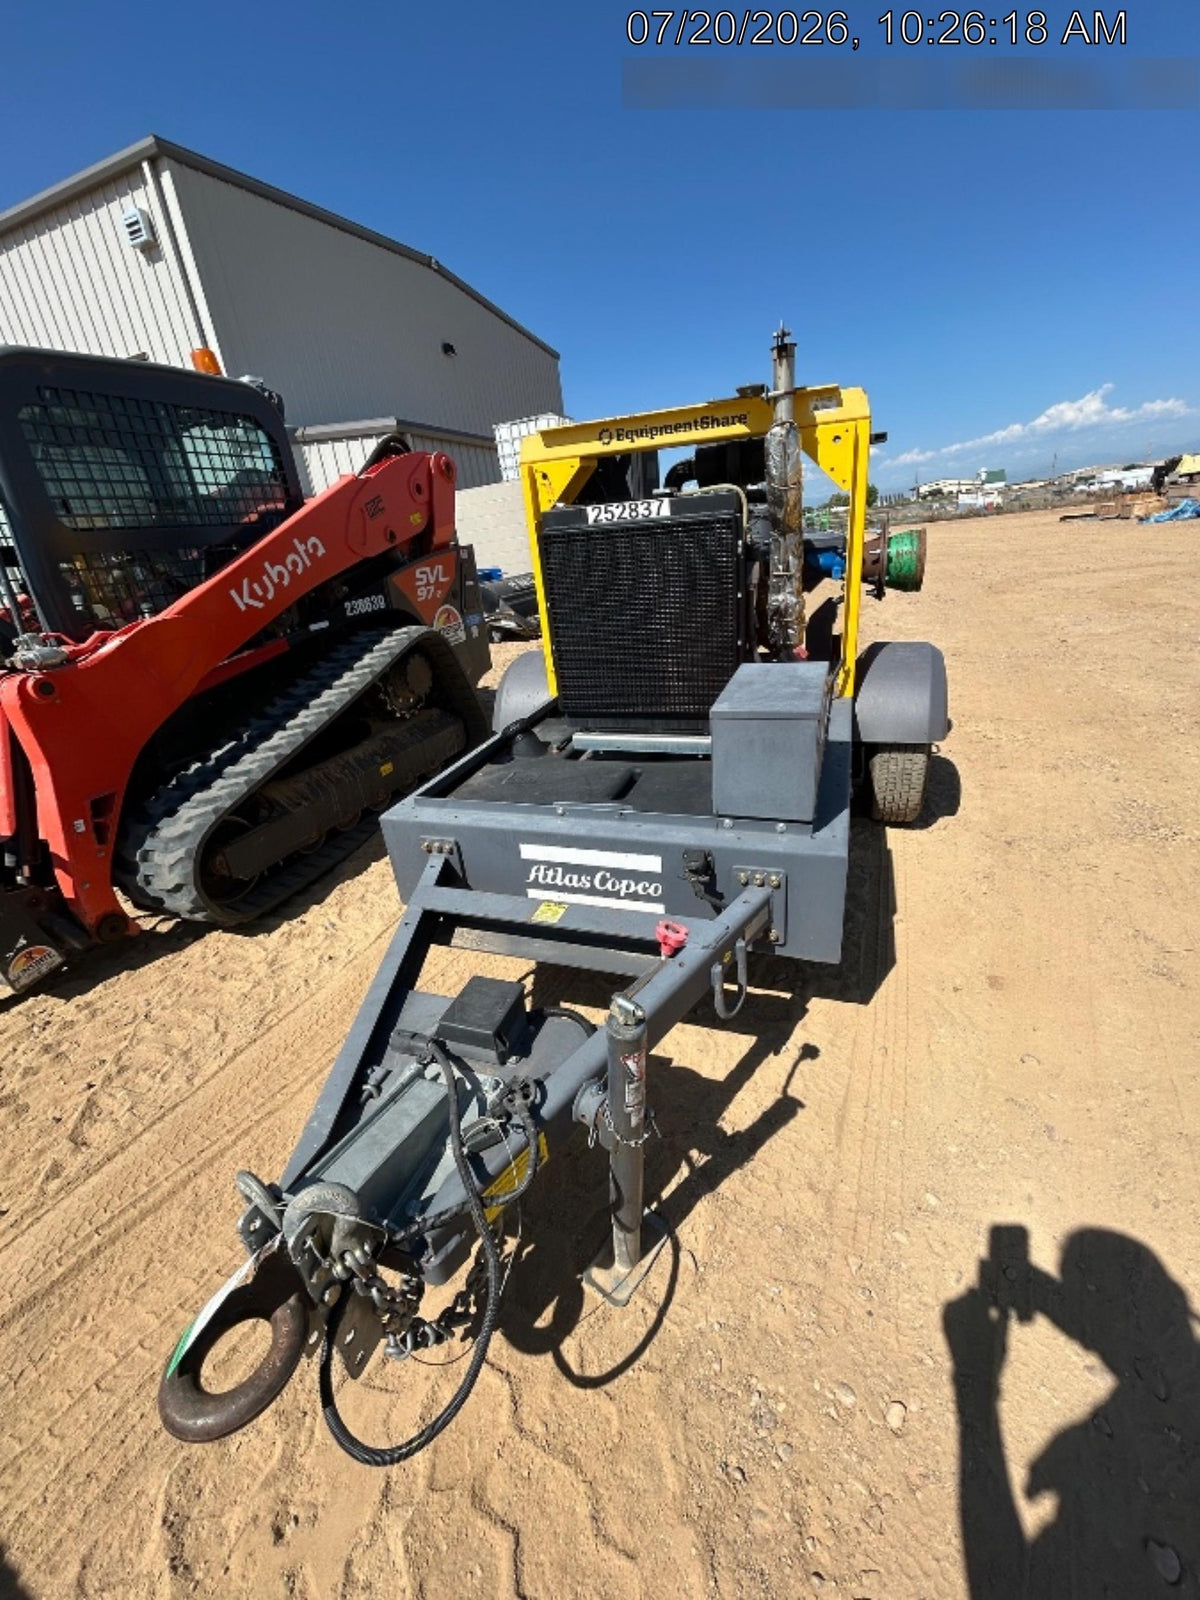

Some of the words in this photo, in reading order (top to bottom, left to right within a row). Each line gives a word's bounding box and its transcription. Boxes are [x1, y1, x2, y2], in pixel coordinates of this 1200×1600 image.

[615, 413, 748, 444] EquipmentShare
[591, 500, 664, 524] 252837
[229, 534, 327, 612] Kubota
[415, 565, 450, 586] SVL
[526, 864, 591, 888] Atlas
[594, 870, 662, 896] Copco
